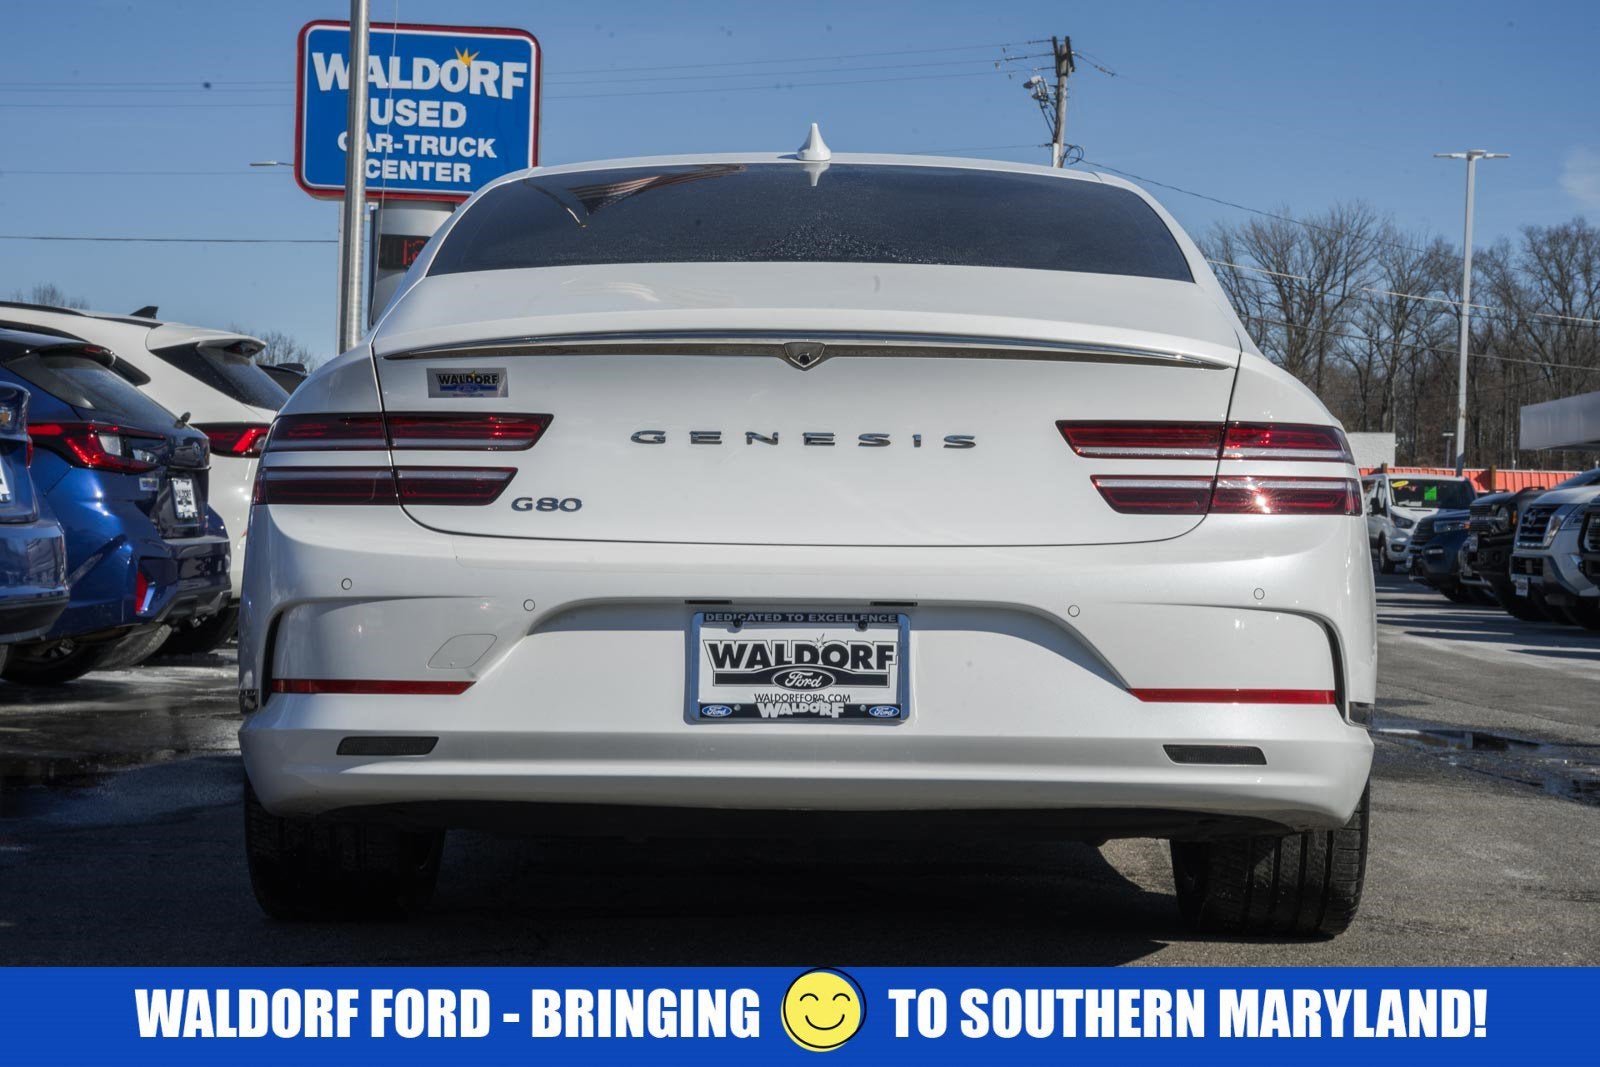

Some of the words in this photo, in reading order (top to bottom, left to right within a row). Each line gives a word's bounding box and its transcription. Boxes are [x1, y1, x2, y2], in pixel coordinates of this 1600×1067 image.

[312, 52, 528, 100] WALDORF
[370, 98, 467, 128] USED
[365, 159, 472, 183] CENTER
[438, 373, 499, 385] WALDORF
[631, 429, 976, 449] GENESIS
[511, 496, 583, 512] G80
[705, 612, 782, 623] DEDICATED
[785, 612, 805, 623] TO
[808, 612, 897, 624] EXCELLENCE
[706, 642, 896, 671] WALDORF
[784, 670, 823, 688] Ford
[754, 693, 851, 703] WALDORFFORD.COM
[706, 706, 728, 717] Ford
[756, 702, 845, 718] WALDORF
[874, 706, 895, 717] Ford
